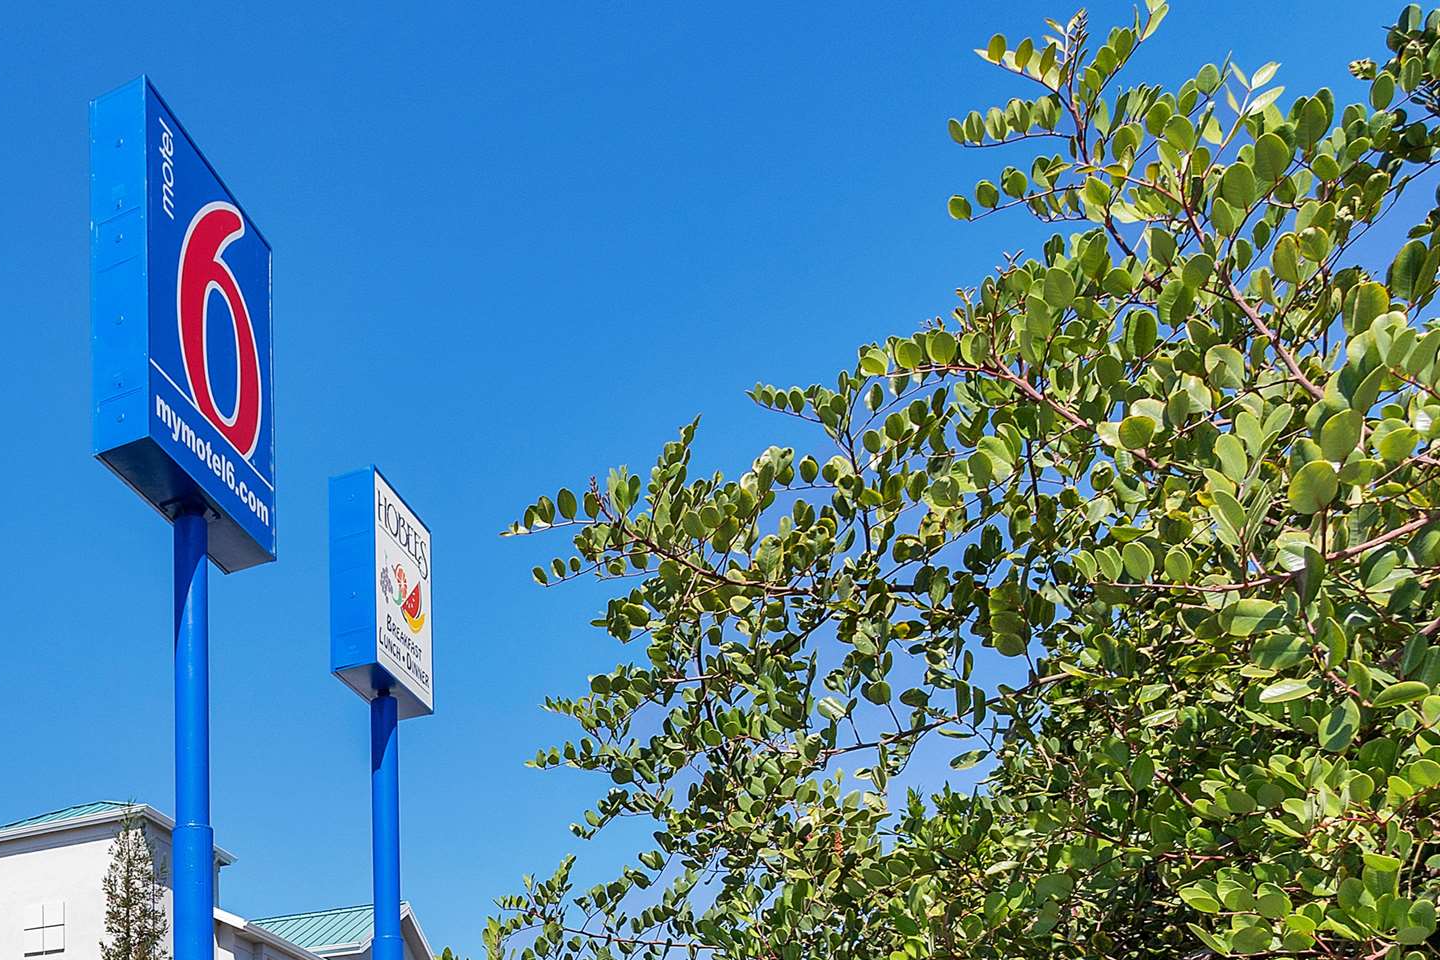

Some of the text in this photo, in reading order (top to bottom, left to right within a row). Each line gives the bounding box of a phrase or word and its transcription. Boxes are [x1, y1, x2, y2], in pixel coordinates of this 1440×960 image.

[159, 117, 174, 220] motel
[177, 200, 262, 462] 6
[155, 394, 269, 527] mymotel6.com
[379, 626, 430, 688] LUNCH DINNER
[386, 613, 422, 661] BREAKFAST
